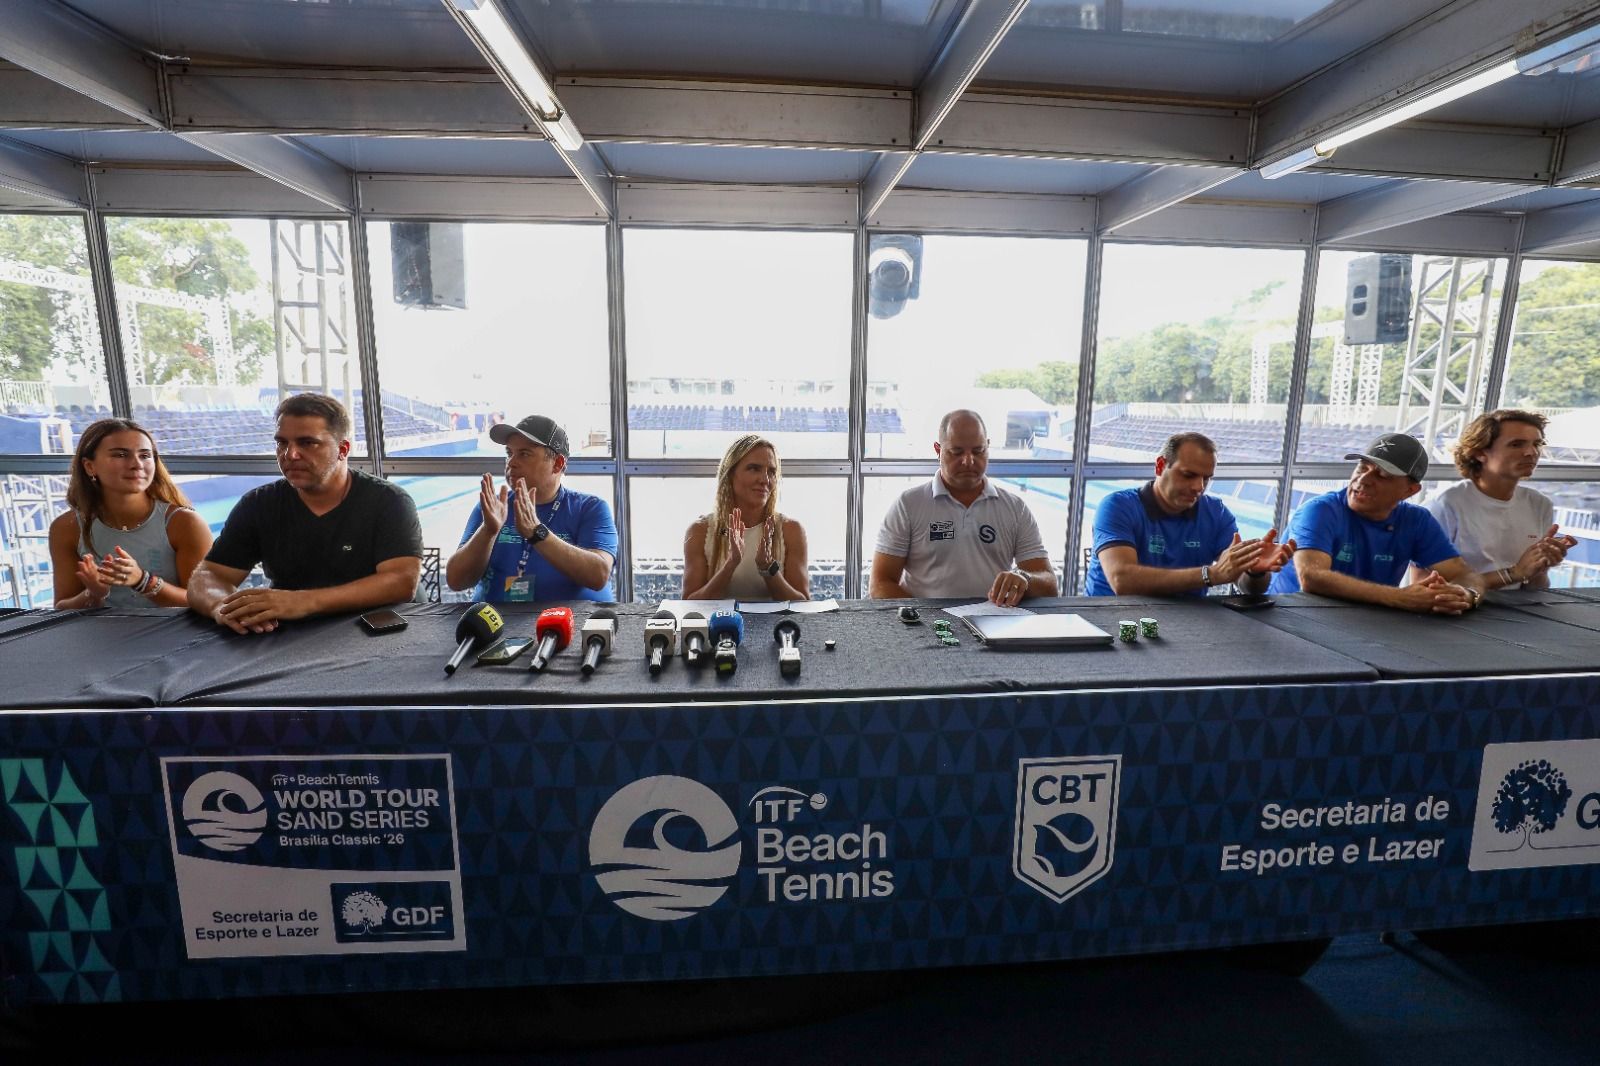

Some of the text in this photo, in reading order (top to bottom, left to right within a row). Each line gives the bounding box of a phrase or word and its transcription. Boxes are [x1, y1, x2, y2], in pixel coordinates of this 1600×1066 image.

[297, 773, 337, 786] Beach
[337, 772, 380, 785] Tennis
[1031, 772, 1106, 806] CBT
[273, 788, 441, 809] WORLD TOUR
[277, 810, 430, 831] SAND SERIES
[755, 800, 804, 823] ITF
[1260, 795, 1450, 830] Secretaria de
[331, 833, 381, 846] Classic
[757, 824, 887, 864] Beach
[1220, 836, 1445, 876] Esporte e Lazer
[757, 861, 895, 902] Tennis
[212, 908, 318, 925] Secretaria de
[392, 906, 445, 926] GDF
[195, 925, 320, 942] Esporte e Lazer
